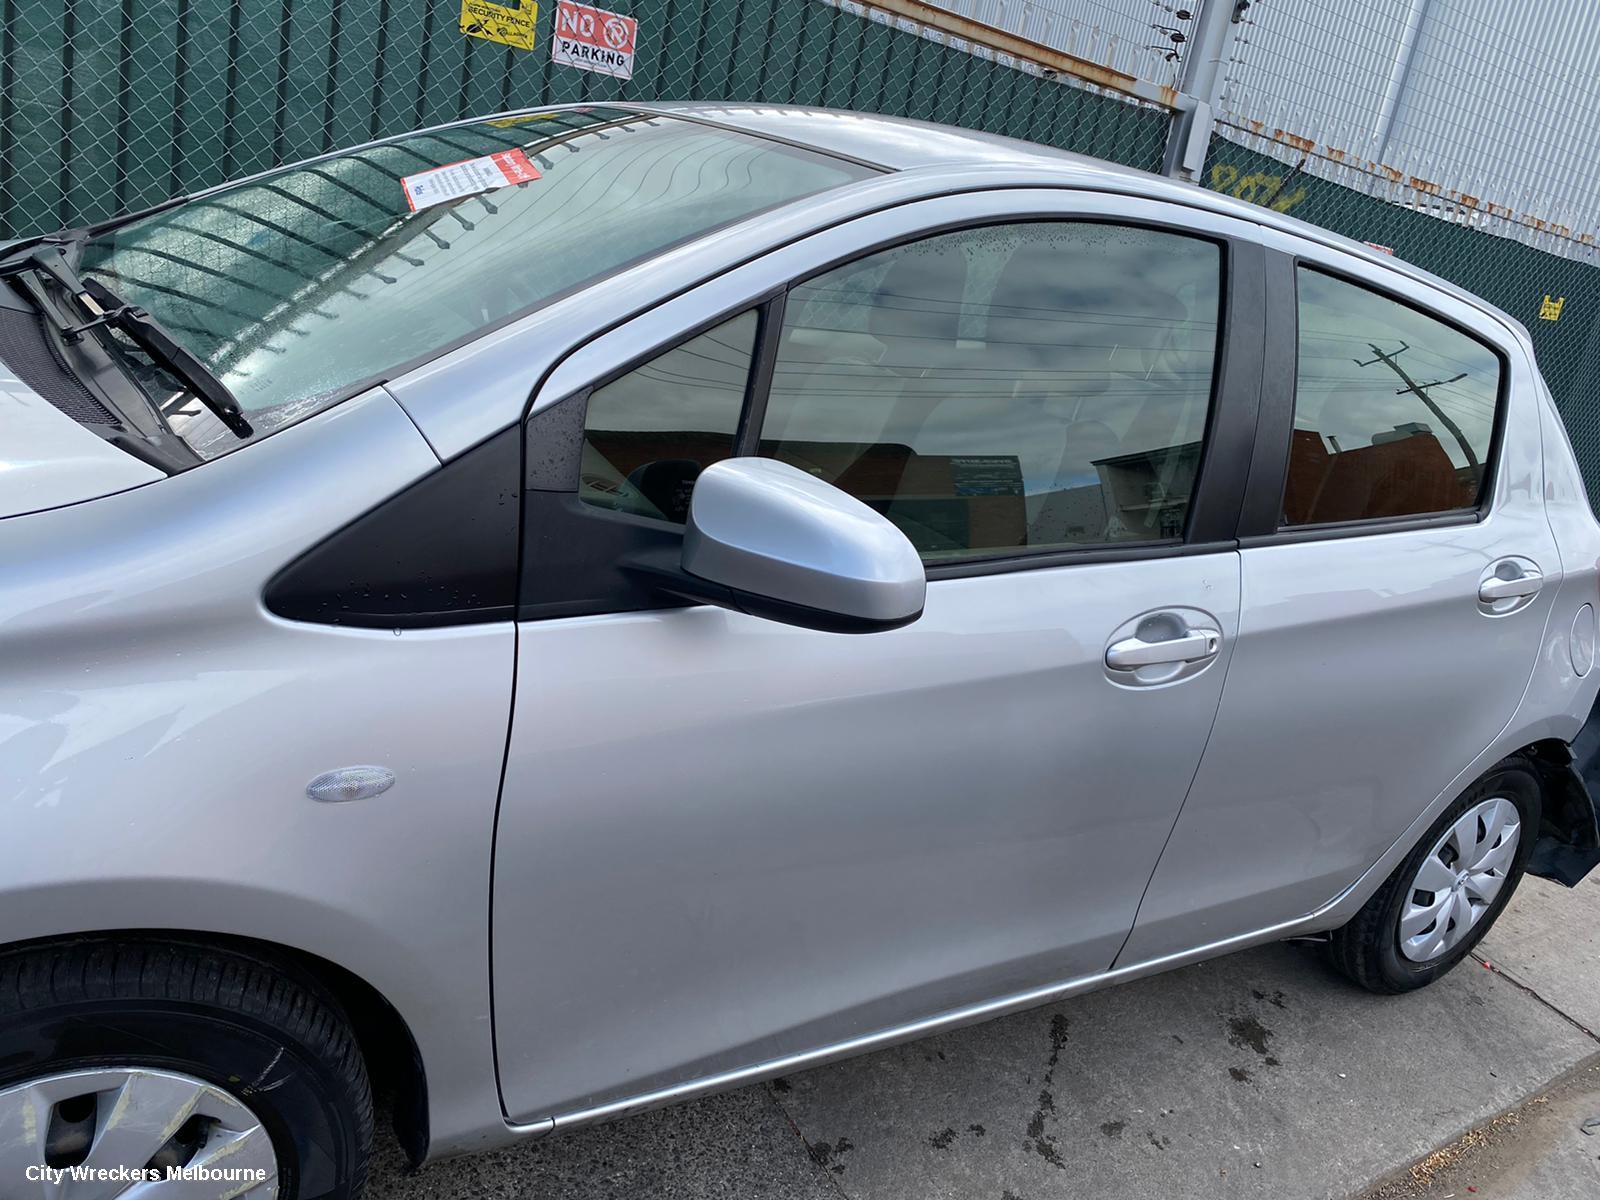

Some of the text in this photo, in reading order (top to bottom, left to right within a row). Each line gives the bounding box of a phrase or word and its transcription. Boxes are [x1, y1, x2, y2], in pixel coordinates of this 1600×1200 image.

[468, 6, 506, 21] SECURITY
[506, 15, 530, 28] FENCE
[561, 8, 595, 38] NO
[561, 41, 625, 66] PARKING
